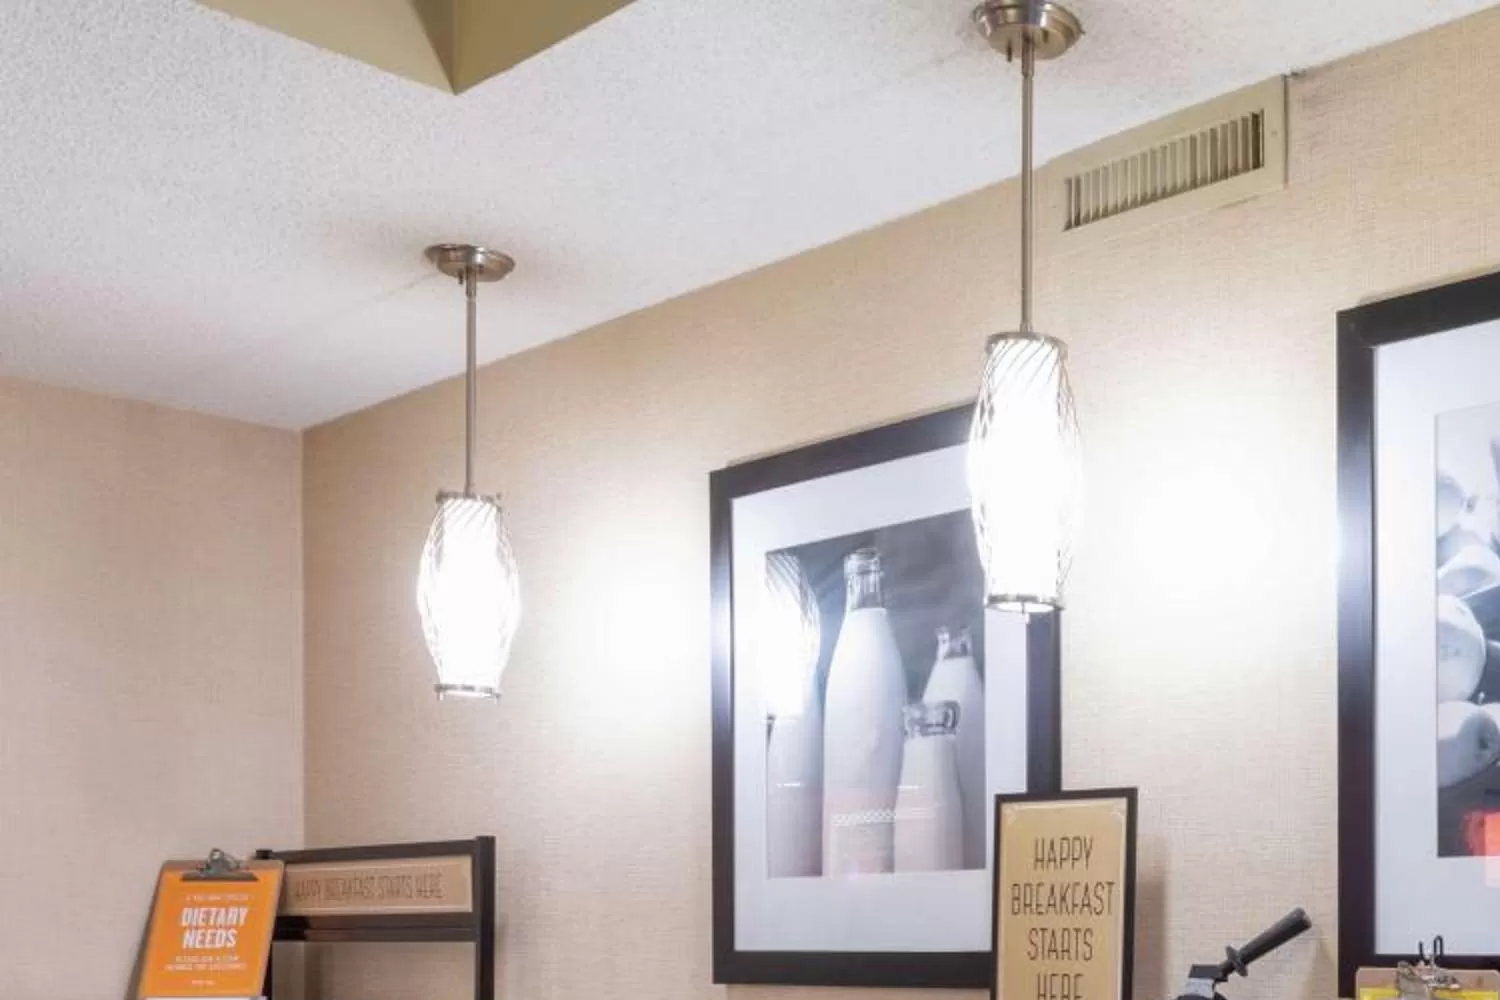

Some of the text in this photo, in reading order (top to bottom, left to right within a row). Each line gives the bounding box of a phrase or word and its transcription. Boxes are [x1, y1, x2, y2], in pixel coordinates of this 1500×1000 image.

[1033, 836, 1094, 870] HAPPY
[1011, 881, 1115, 916] BREAKFAST
[181, 906, 249, 927] DIETARY
[183, 928, 238, 949] NEEDS
[1027, 927, 1095, 961] STARTS
